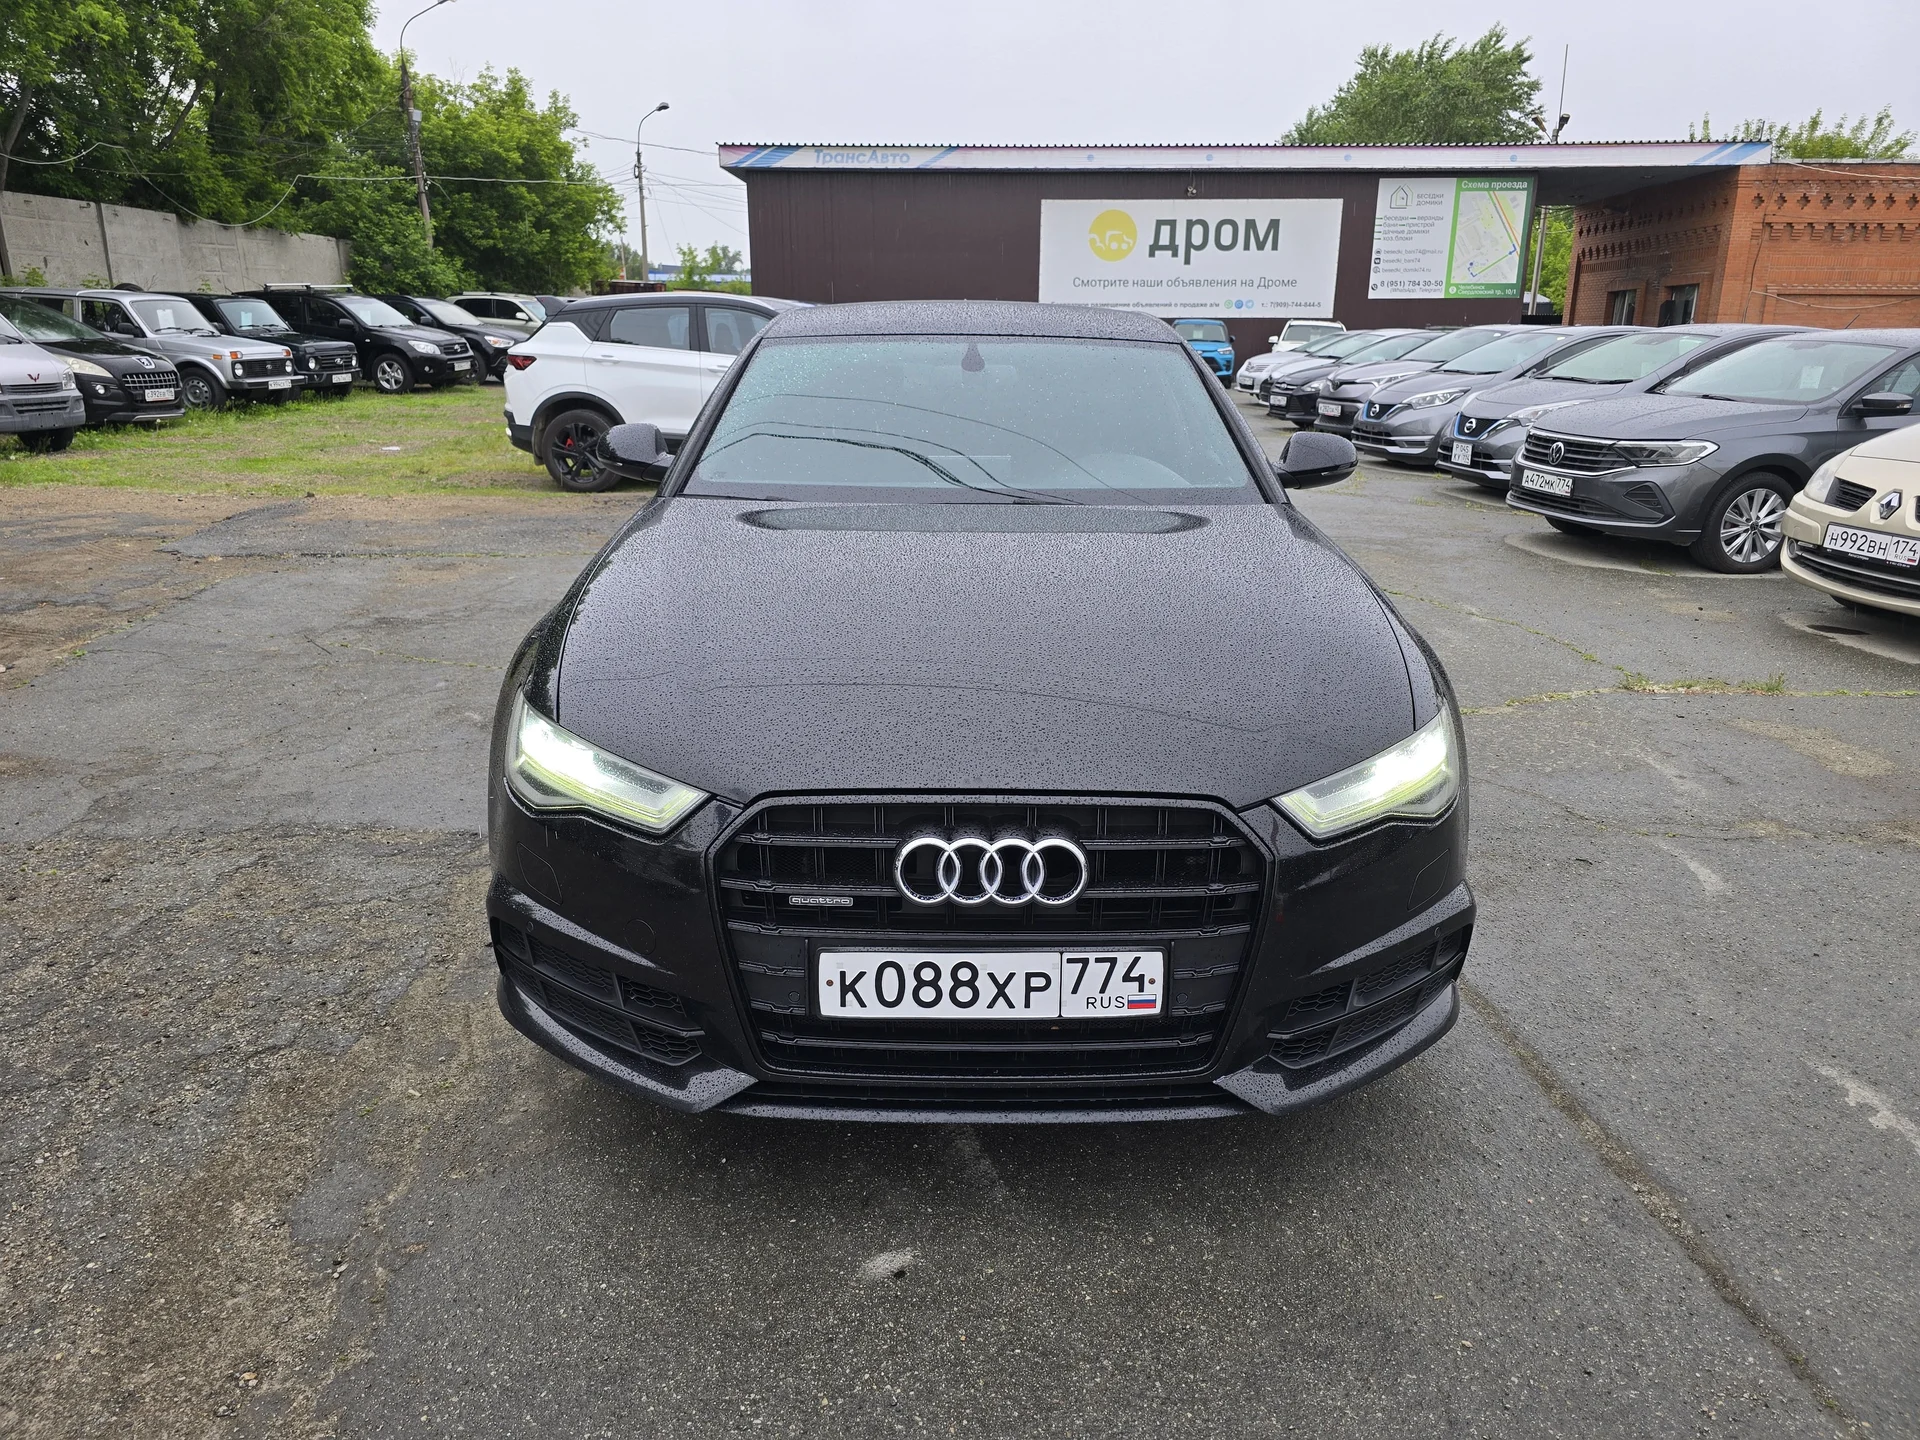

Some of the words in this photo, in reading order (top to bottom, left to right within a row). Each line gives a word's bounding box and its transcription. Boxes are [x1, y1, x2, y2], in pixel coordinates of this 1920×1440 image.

[814, 150, 910, 165] ТрансАвто
[1461, 180, 1489, 189] Схема
[1491, 181, 1528, 190] проезда
[1148, 218, 1281, 265] дром
[1072, 277, 1129, 289] Смотрите
[1132, 280, 1163, 288] наши
[1166, 277, 1237, 288] объявления
[1240, 280, 1254, 288] на
[1257, 277, 1298, 289] Дроме
[1524, 473, 1555, 491] А472МК
[1828, 531, 1888, 556] Н992ВН
[1892, 539, 1918, 557] 174
[839, 960, 1052, 1010] К088ХР
[1065, 956, 1145, 996] 774
[1086, 996, 1125, 1009] RUS
